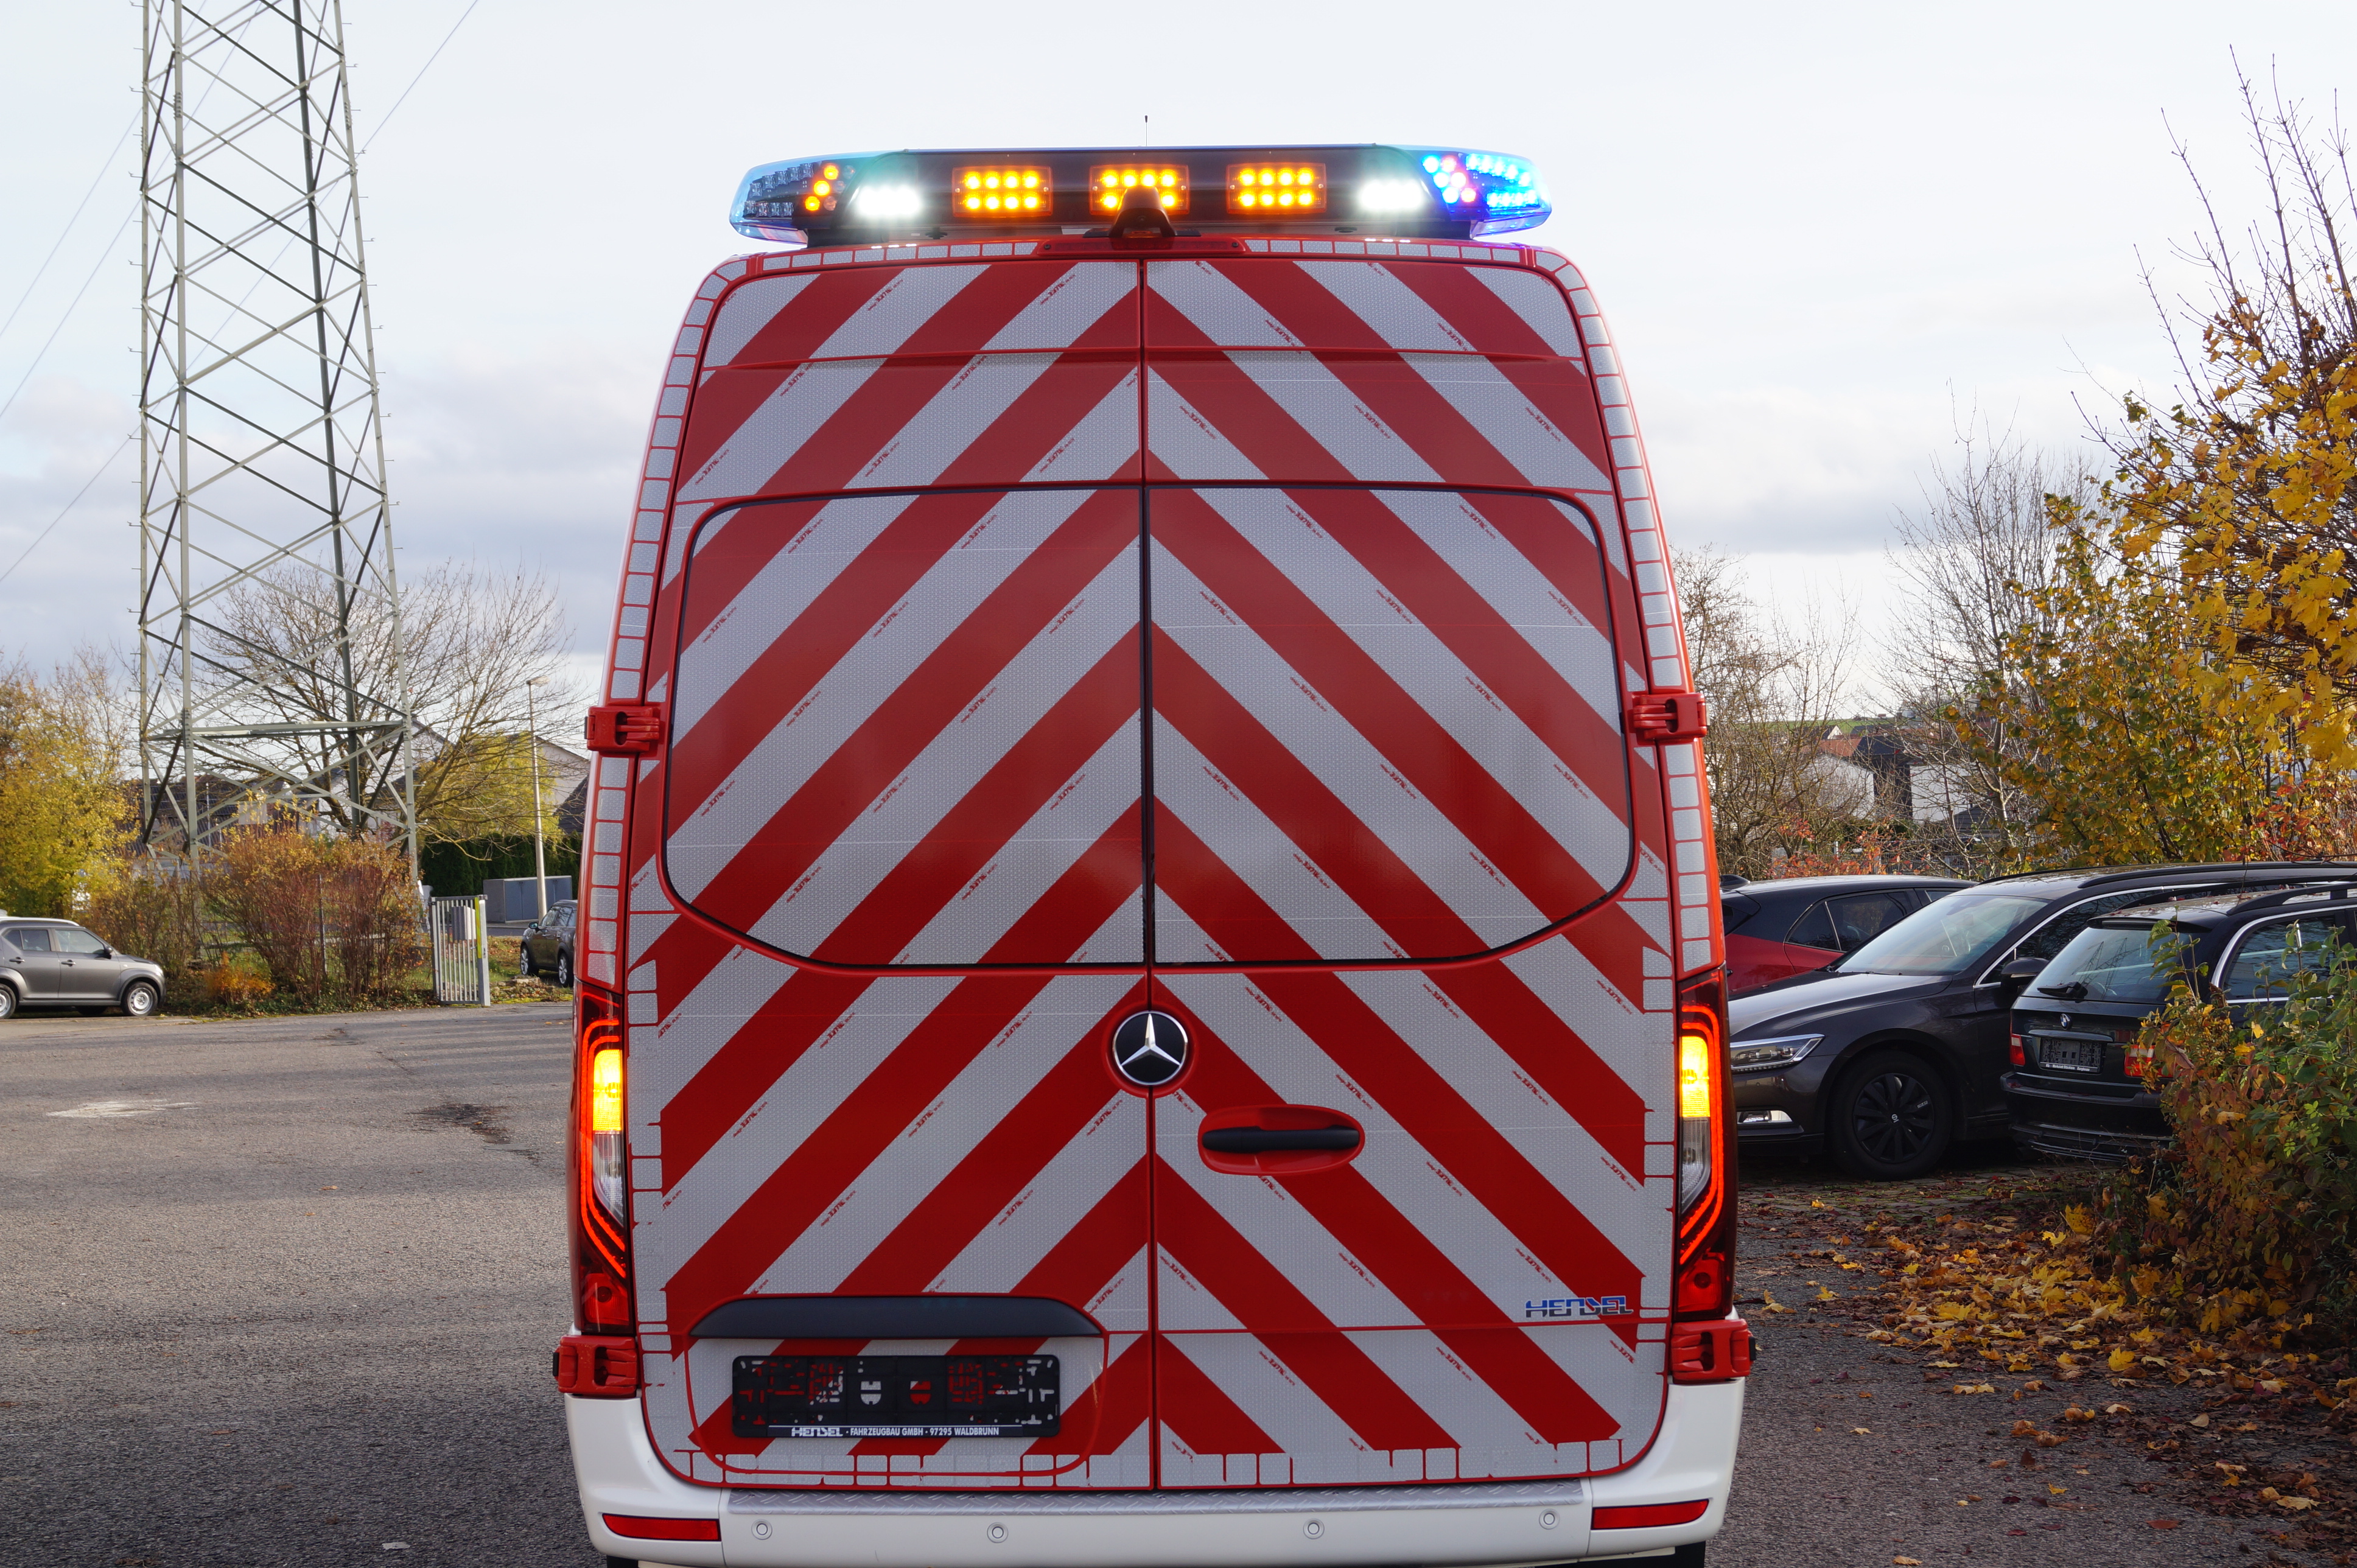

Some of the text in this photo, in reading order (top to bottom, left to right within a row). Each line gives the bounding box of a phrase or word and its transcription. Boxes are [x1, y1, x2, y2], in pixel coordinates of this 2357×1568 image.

[1525, 1295, 1634, 1318] HENSEL
[791, 1427, 1000, 1437] HENSEL FAHRZEUGBAU GMBH 97295 WALDBRUNN
